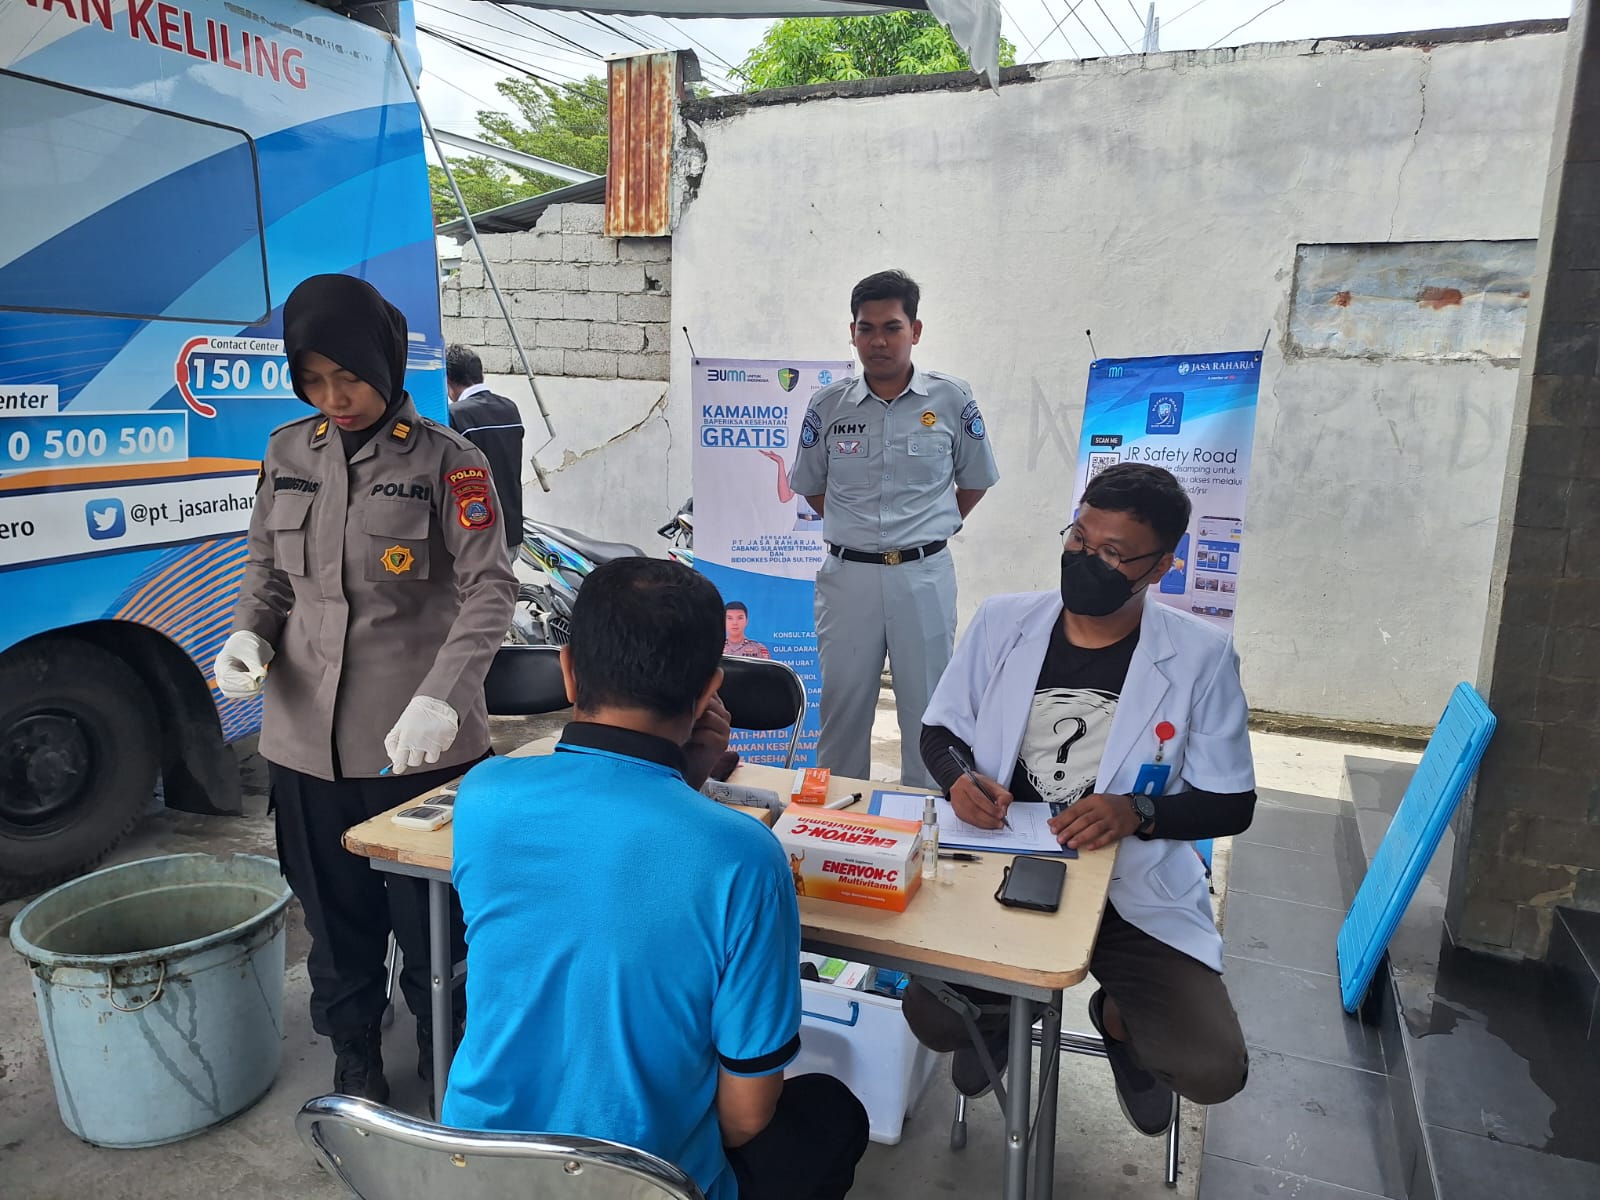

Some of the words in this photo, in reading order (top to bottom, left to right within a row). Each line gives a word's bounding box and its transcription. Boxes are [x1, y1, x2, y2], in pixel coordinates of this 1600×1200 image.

[128, 0, 307, 90] KELILING
[210, 338, 247, 350] Contact
[249, 340, 280, 352] Center
[193, 358, 251, 390] 150
[1191, 362, 1211, 373] JASA
[1212, 360, 1255, 371] RAHARJA
[703, 404, 788, 419] KAMAIMO!
[703, 427, 786, 447] GRATIS
[833, 424, 867, 435] IKHY
[43, 428, 107, 460] 500
[118, 425, 175, 455] 500
[1124, 446, 1140, 461] JR
[1143, 447, 1191, 465] Safety
[1192, 448, 1238, 464] Road
[450, 469, 484, 482] POLDA
[1173, 465, 1211, 475] disamping
[1212, 465, 1236, 475] untuk
[1189, 476, 1210, 484] akses
[1212, 477, 1243, 486] melalui
[370, 483, 430, 500] POLRI
[130, 493, 255, 526] @pt_jasarahar
[777, 730, 788, 739] DI
[726, 743, 764, 752] MAKAN
[748, 754, 808, 763] KESEHAAN
[797, 816, 878, 835] Multivitamin
[790, 824, 898, 849] ENERVON-C
[821, 859, 899, 883] ENERVON-C
[838, 875, 898, 892] Multivitamin
